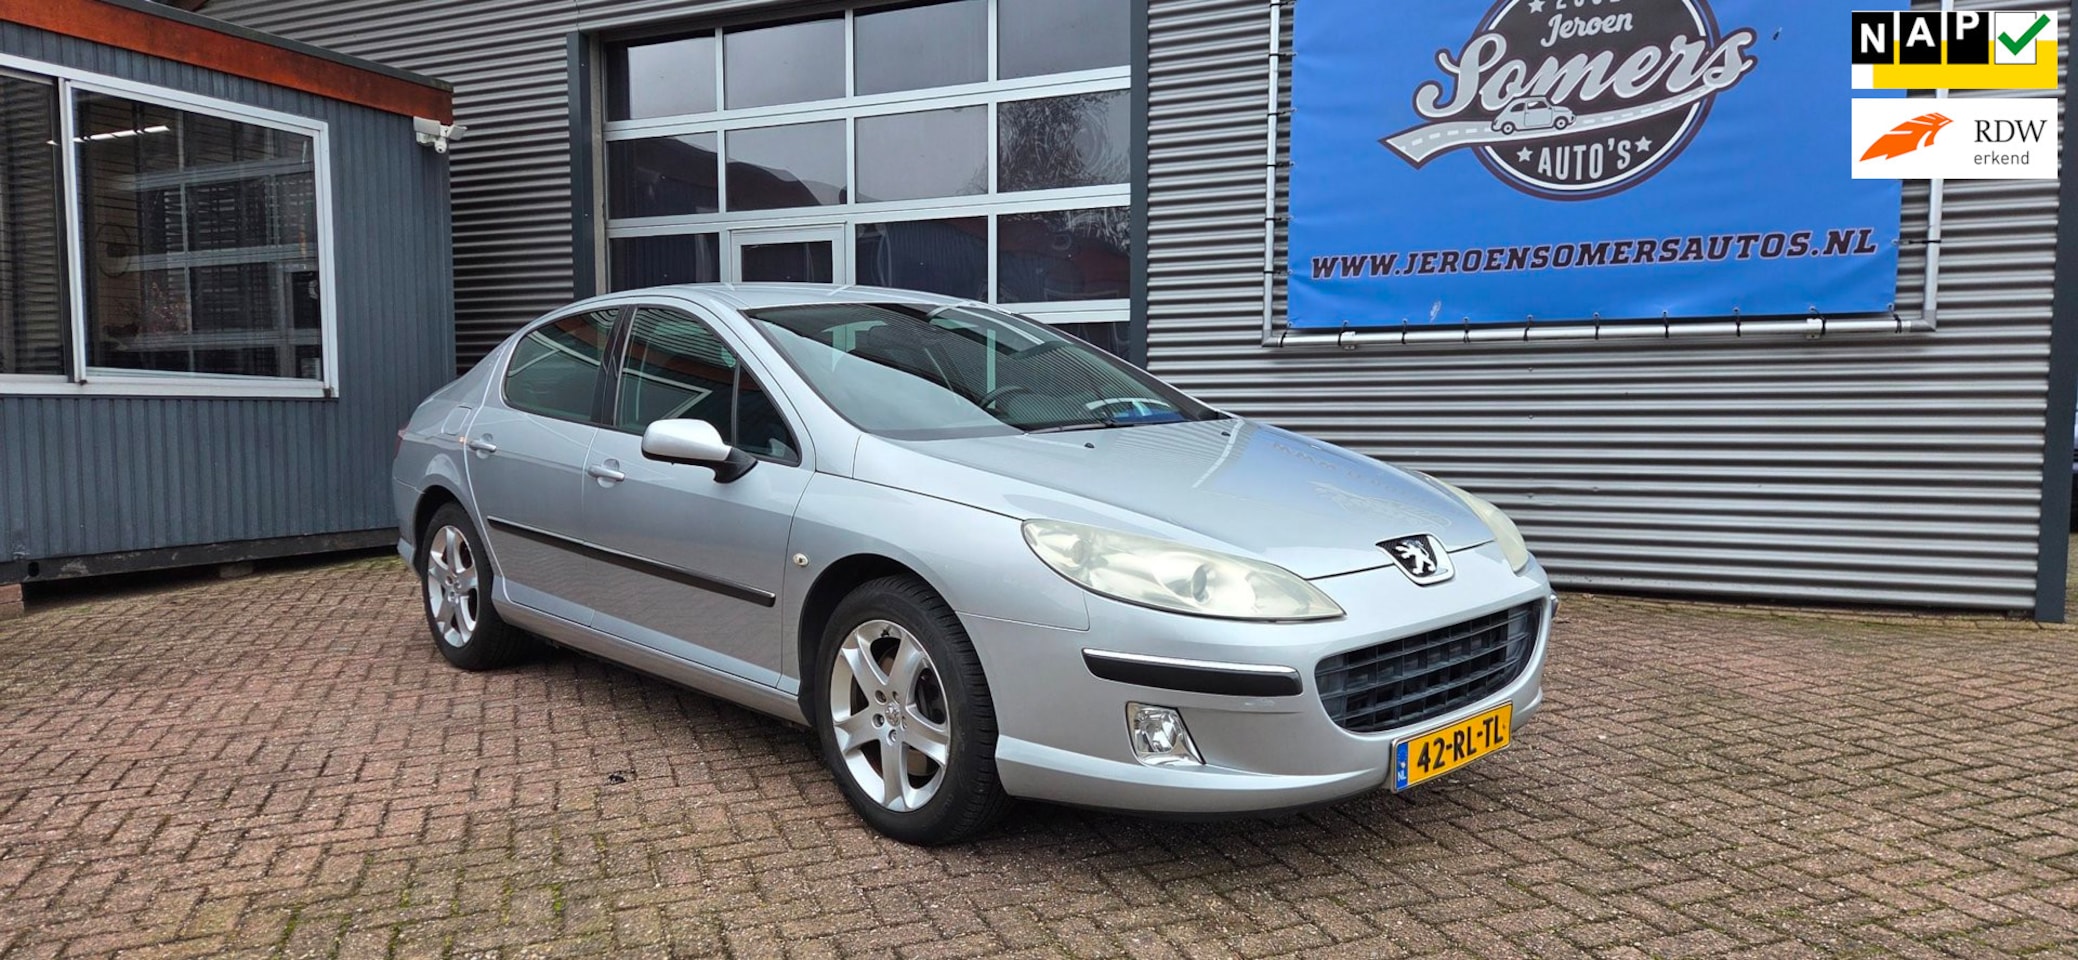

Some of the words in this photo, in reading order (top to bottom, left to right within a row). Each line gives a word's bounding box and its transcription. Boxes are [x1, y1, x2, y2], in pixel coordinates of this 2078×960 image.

[1540, 13, 1633, 47] Jeroen
[1416, 32, 1753, 118] Somers
[1537, 138, 1631, 181] AUTO'S
[1311, 228, 1877, 279] WWW.JEROENSOMERSAUTOS.NL
[1417, 715, 1503, 773] 42-RL-TL
[1398, 769, 1406, 781] NL
